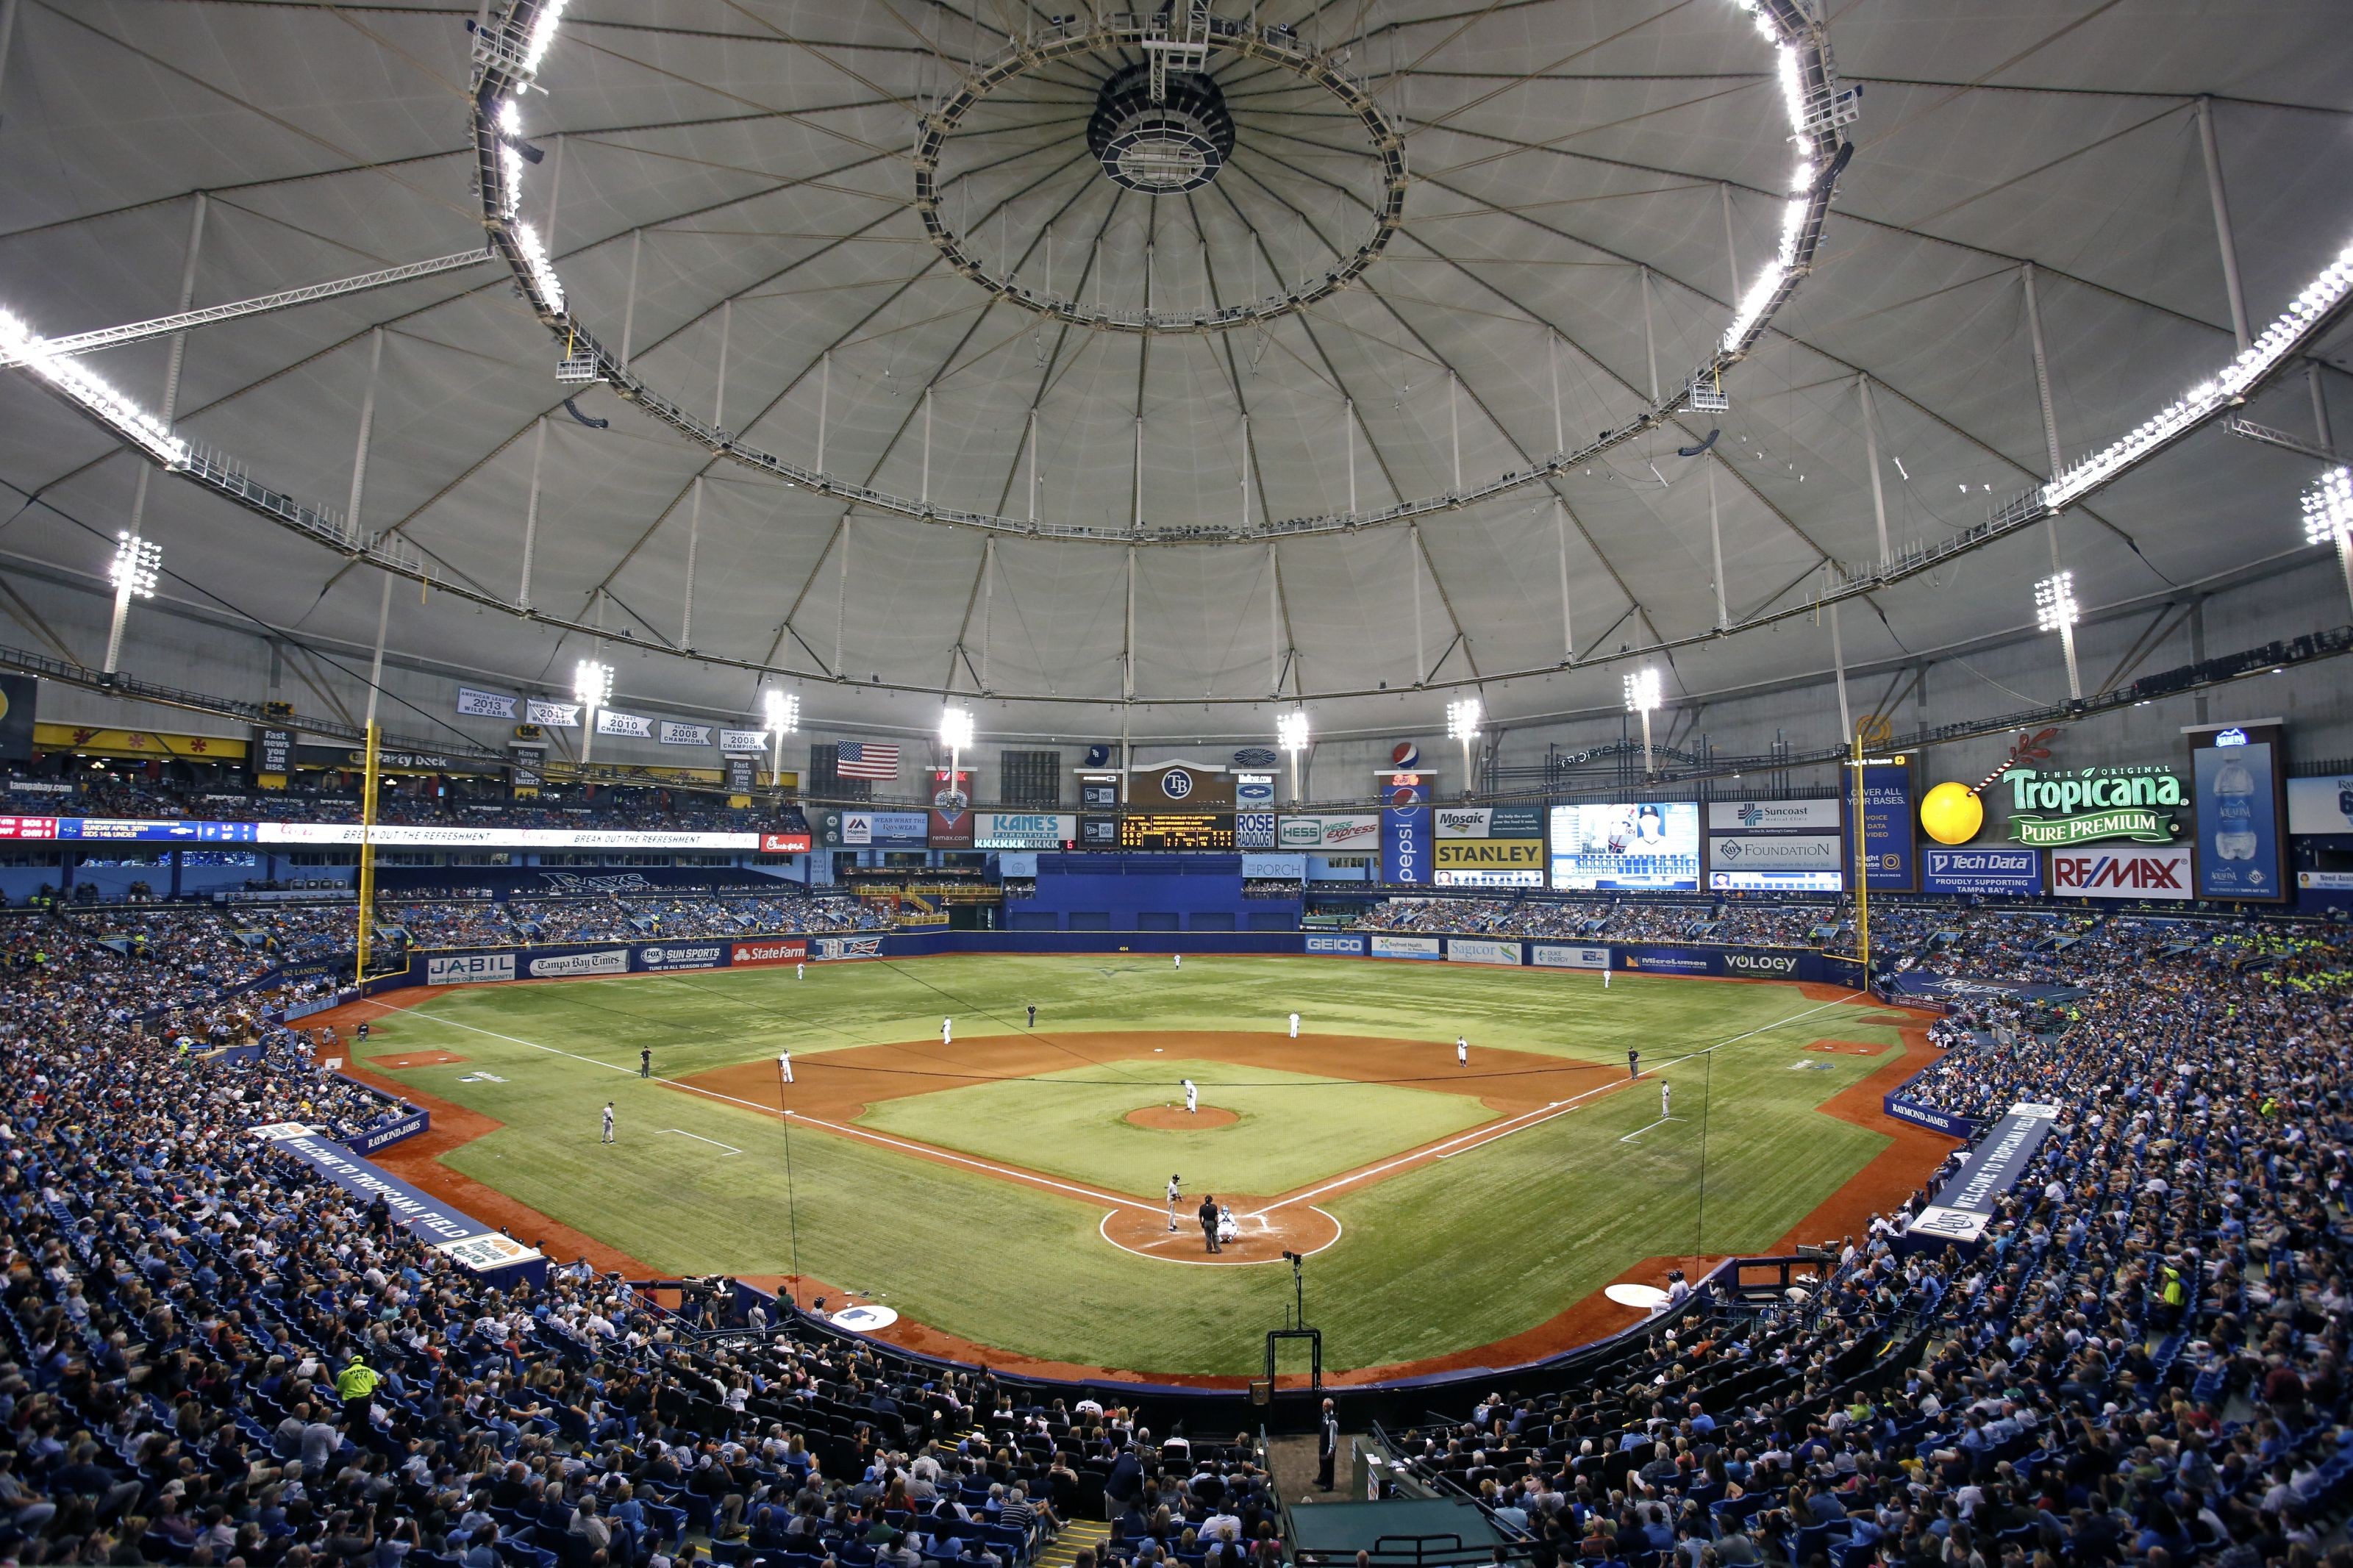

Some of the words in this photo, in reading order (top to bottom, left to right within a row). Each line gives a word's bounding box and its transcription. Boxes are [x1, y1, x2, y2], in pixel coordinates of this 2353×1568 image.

[462, 691, 490, 700] AMERICAN
[492, 695, 513, 704] LEAGUE
[474, 699, 501, 710] 2013
[487, 709, 507, 717] CARD
[540, 709, 565, 719] 2011
[532, 716, 549, 724] WILD
[610, 719, 638, 729] 2010
[265, 730, 286, 740] Fast
[601, 726, 644, 736] CHAMPIONS
[672, 729, 698, 738] 2008
[263, 740, 290, 748] news
[731, 736, 754, 744] 2008
[267, 748, 285, 756] you
[518, 749, 539, 758] Have
[1092, 749, 1099, 758] TB
[267, 755, 285, 763] can
[415, 755, 447, 767] Deck
[2101, 765, 2171, 776] ORIGINAL
[10, 781, 72, 792] tampabay.com
[1168, 775, 1188, 793] TB
[2003, 769, 2180, 814] Tropicana
[1874, 797, 1905, 805] BASES.
[1765, 807, 1807, 815] Suncoast
[2220, 806, 2251, 817] AQUAFINA
[993, 815, 1058, 831] KANE'S
[1237, 815, 1274, 831] ROSE
[1440, 812, 1484, 824] Mosaic
[207, 828, 215, 836] F
[1323, 821, 1354, 832] HESS
[2022, 823, 2066, 841] PURE
[2070, 815, 2156, 838] PREMIUM
[379, 831, 399, 839] OUT
[403, 831, 421, 840] THE
[424, 831, 491, 841] REFRESHMENT
[1283, 828, 1318, 837] HESS
[642, 835, 701, 844] REFRESHMENT
[1067, 840, 1073, 848] 6
[1237, 831, 1273, 846] RADIOLOGY
[1396, 823, 1417, 882] pepsi
[1439, 846, 1538, 862] STANLEY
[1746, 843, 1829, 856] FOUNDATION
[1952, 855, 1985, 869] Tech
[1988, 855, 2027, 870] Data
[1257, 864, 1300, 876] PORCH
[2054, 856, 2182, 889] RE/MAX
[539, 873, 650, 890] RAYS
[2211, 871, 2237, 881] AQUAFINA
[1307, 938, 1362, 951] GEICO
[1452, 942, 1495, 958] Sagicor
[666, 949, 685, 958] SUN
[685, 948, 721, 958] SPORTS
[430, 957, 513, 974] JABIL
[538, 960, 570, 971] Tampa
[572, 957, 590, 969] Bay
[592, 956, 619, 966] Times
[1642, 957, 1707, 967] MicroLumen
[1724, 955, 1797, 973] VOLOGY
[295, 965, 329, 975] LANDING
[430, 976, 460, 984] SUPPORTS
[476, 974, 513, 982] COMMUNITY
[1892, 1103, 1926, 1123] RAYMOND
[1926, 1113, 1949, 1128] JAMES
[2012, 1117, 2038, 1131] FIELD
[368, 1128, 400, 1149] RAYMOND
[398, 1120, 421, 1139] JAMES
[1987, 1131, 2029, 1162] TROPICANA
[1980, 1163, 2005, 1173] TO
[287, 1137, 340, 1166] WELCOME
[332, 1161, 360, 1175] TO
[348, 1172, 427, 1218] TROPICANA
[418, 1212, 470, 1238] FIELD
[1952, 1173, 1999, 1209] WELCOME
[1921, 1212, 1975, 1235] RAYS
[468, 1239, 507, 1260] Tropicana
